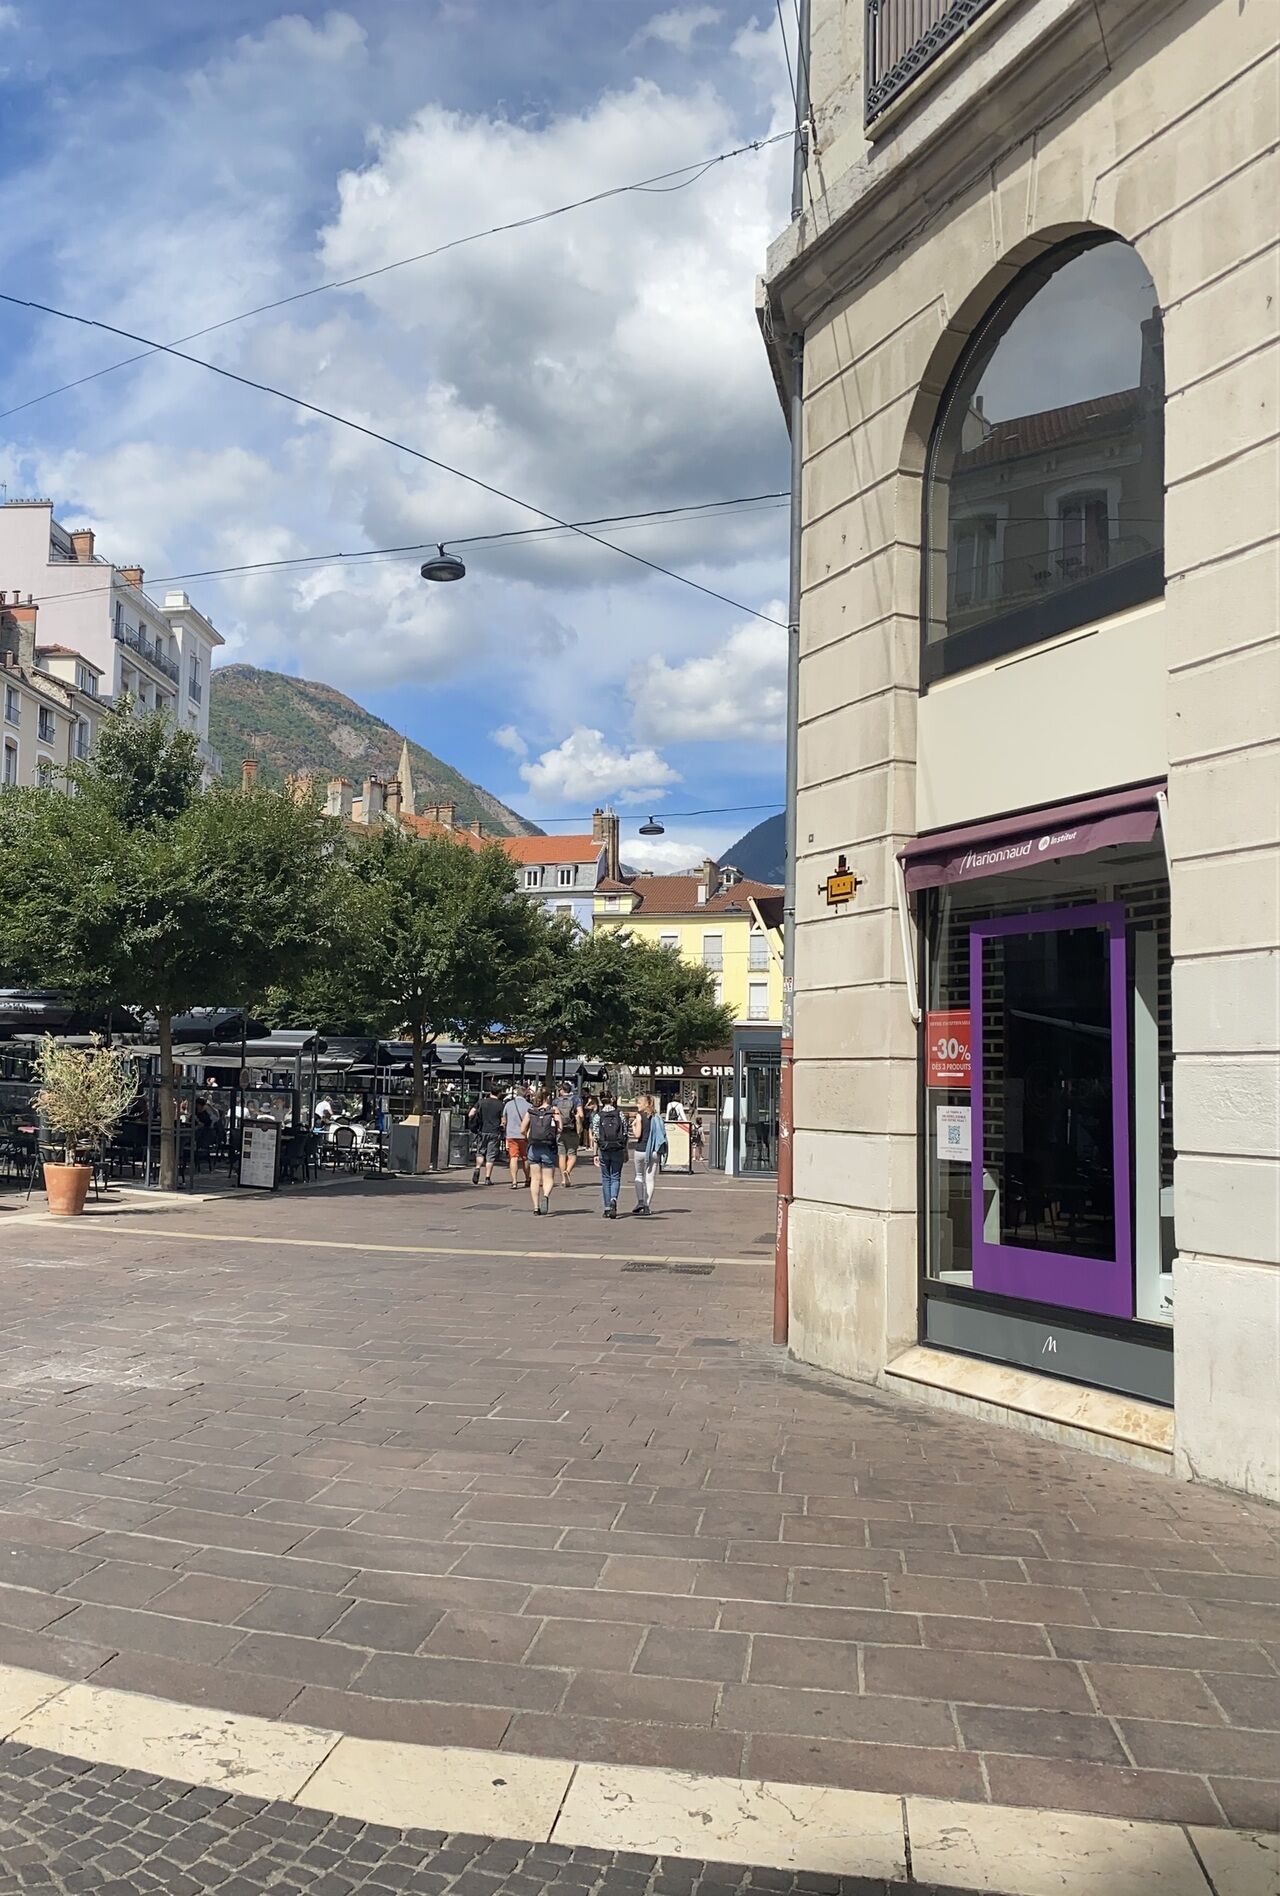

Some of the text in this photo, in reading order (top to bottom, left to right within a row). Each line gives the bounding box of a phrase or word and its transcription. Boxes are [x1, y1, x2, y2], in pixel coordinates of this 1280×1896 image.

[959, 831, 1077, 874] Marionnaud Institut
[931, 1037, 972, 1061] -30%
[947, 1063, 972, 1071] PRODUITS
